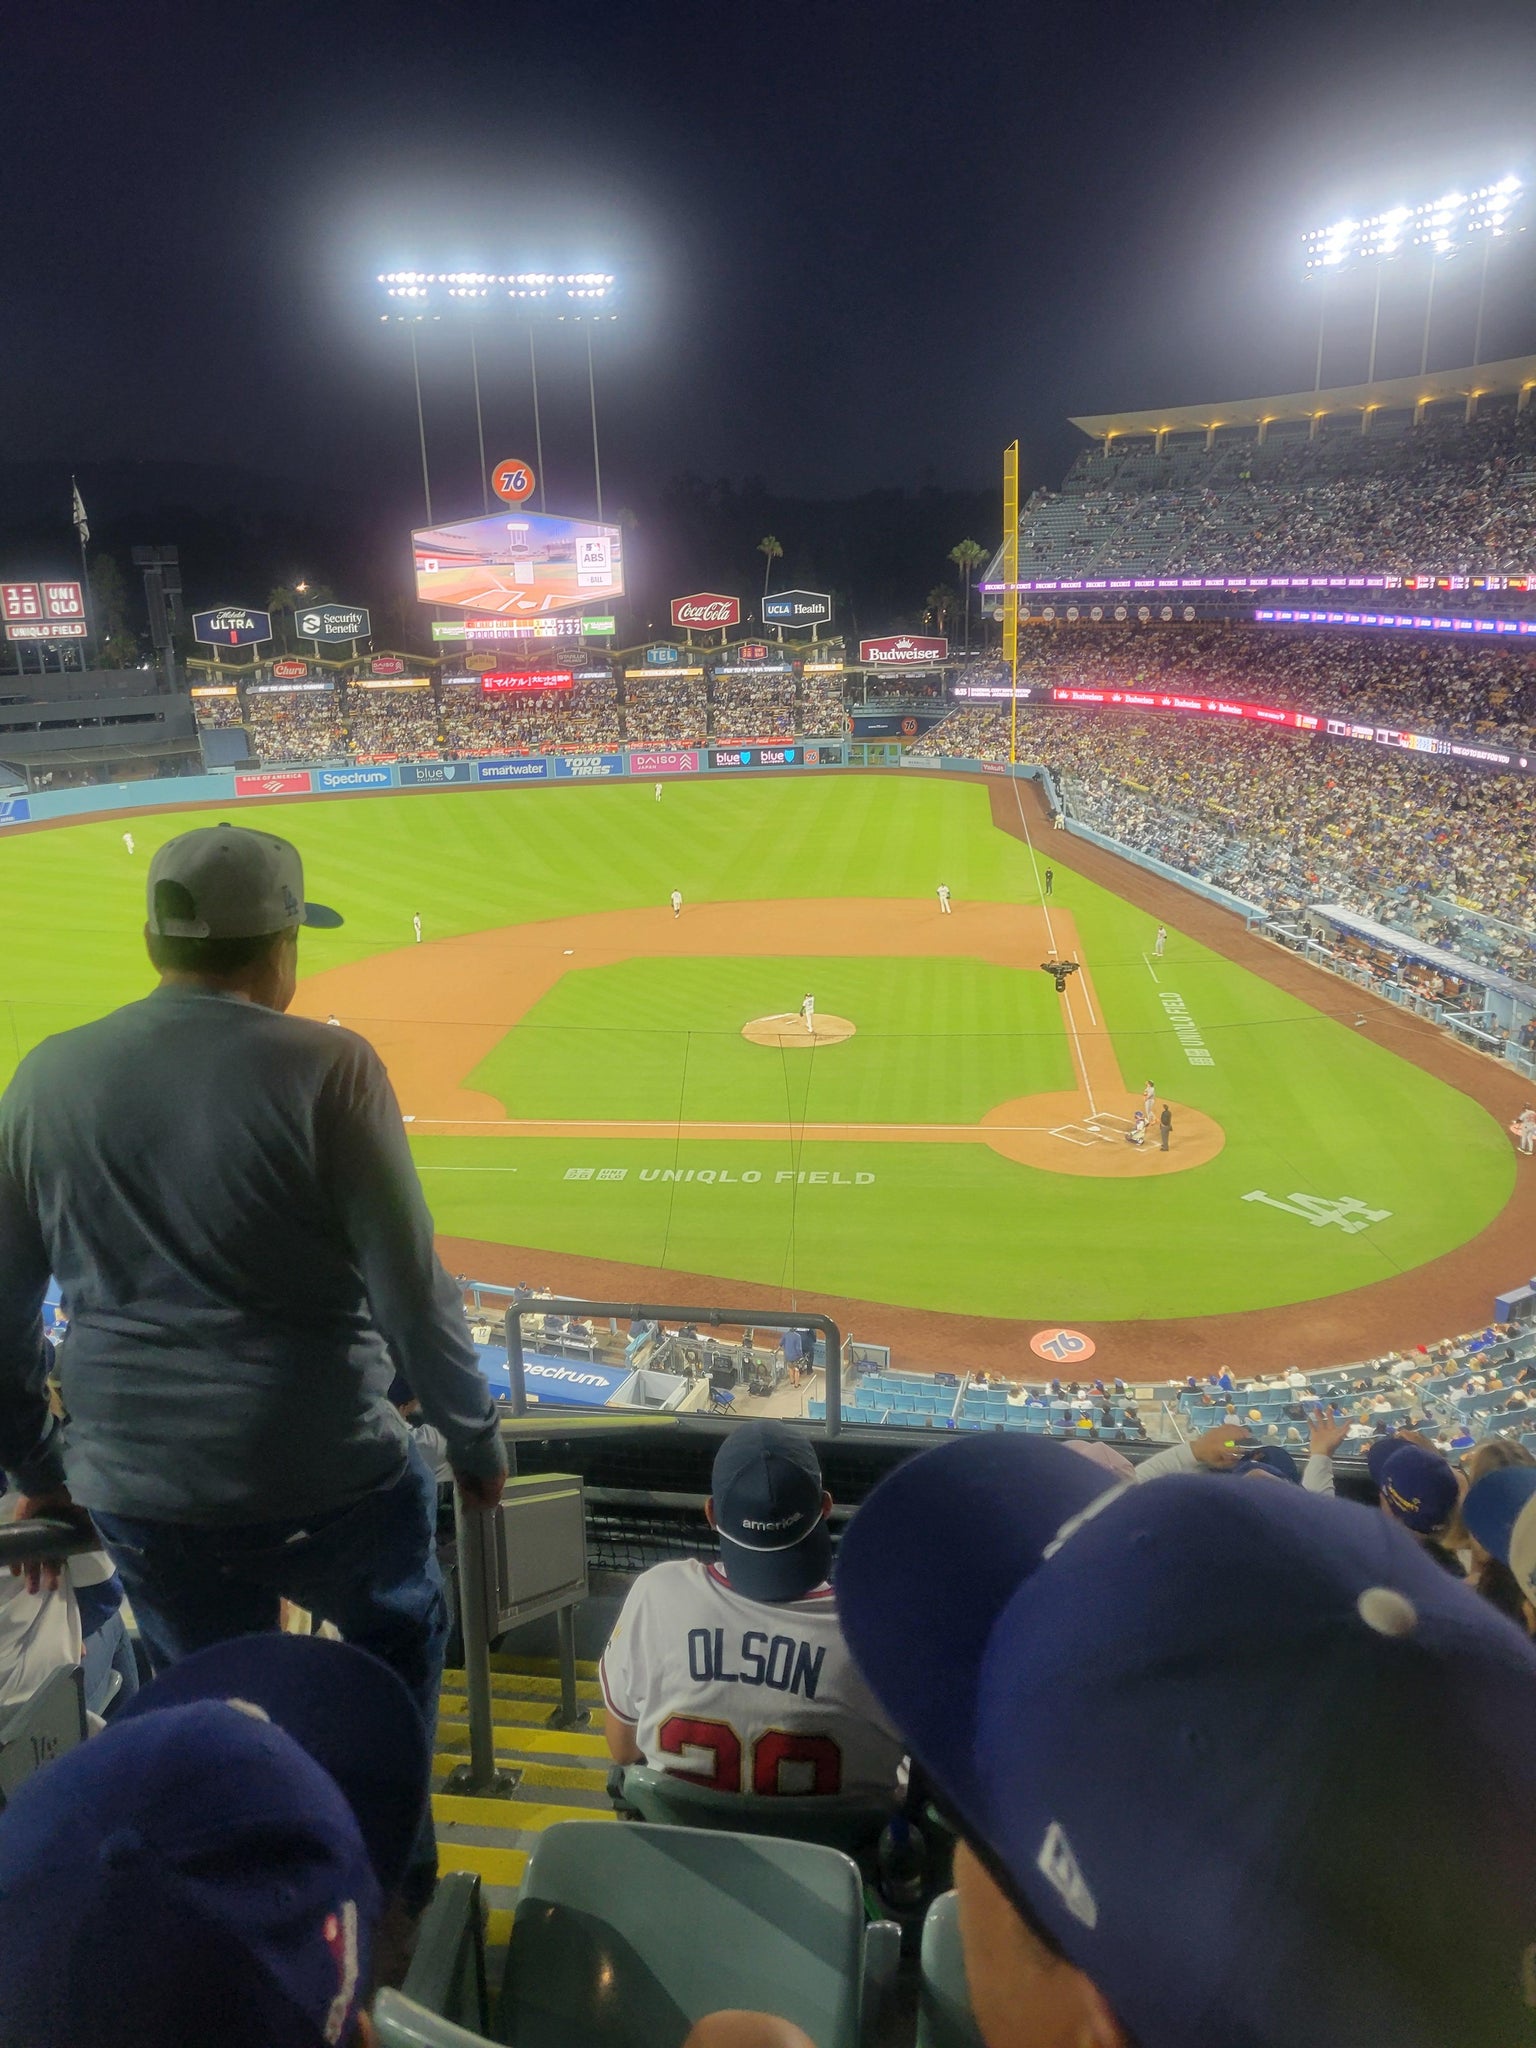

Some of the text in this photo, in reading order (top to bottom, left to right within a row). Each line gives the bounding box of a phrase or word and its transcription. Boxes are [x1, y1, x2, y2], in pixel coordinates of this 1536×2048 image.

[501, 469, 527, 492] 76
[584, 554, 603, 562] ABS
[49, 587, 74, 599] UNI
[52, 601, 79, 615] QLO
[678, 601, 733, 621] Coca-Cola
[767, 604, 825, 614] UCLA Health
[323, 612, 362, 625] Security
[210, 619, 254, 630] ULTRA
[325, 623, 359, 634] Benefit
[558, 624, 565, 634] 2
[566, 624, 573, 634] 3
[574, 623, 580, 634] 2
[12, 625, 82, 637] UNIQLO FIELD
[651, 650, 674, 660] TEL
[275, 664, 306, 676] Churu
[904, 720, 914, 729] 76
[637, 755, 677, 765] DAISO
[716, 752, 740, 763] blue
[761, 751, 784, 761] blue
[565, 758, 602, 767] TOYO
[416, 768, 443, 779] blue
[482, 764, 543, 777] smartwater
[571, 766, 610, 775] TIRES
[323, 773, 383, 787] Spectrum
[639, 1169, 876, 1185] UNIQLO FIELD
[1040, 1331, 1086, 1360] 76
[688, 1628, 826, 1699] OLSON
